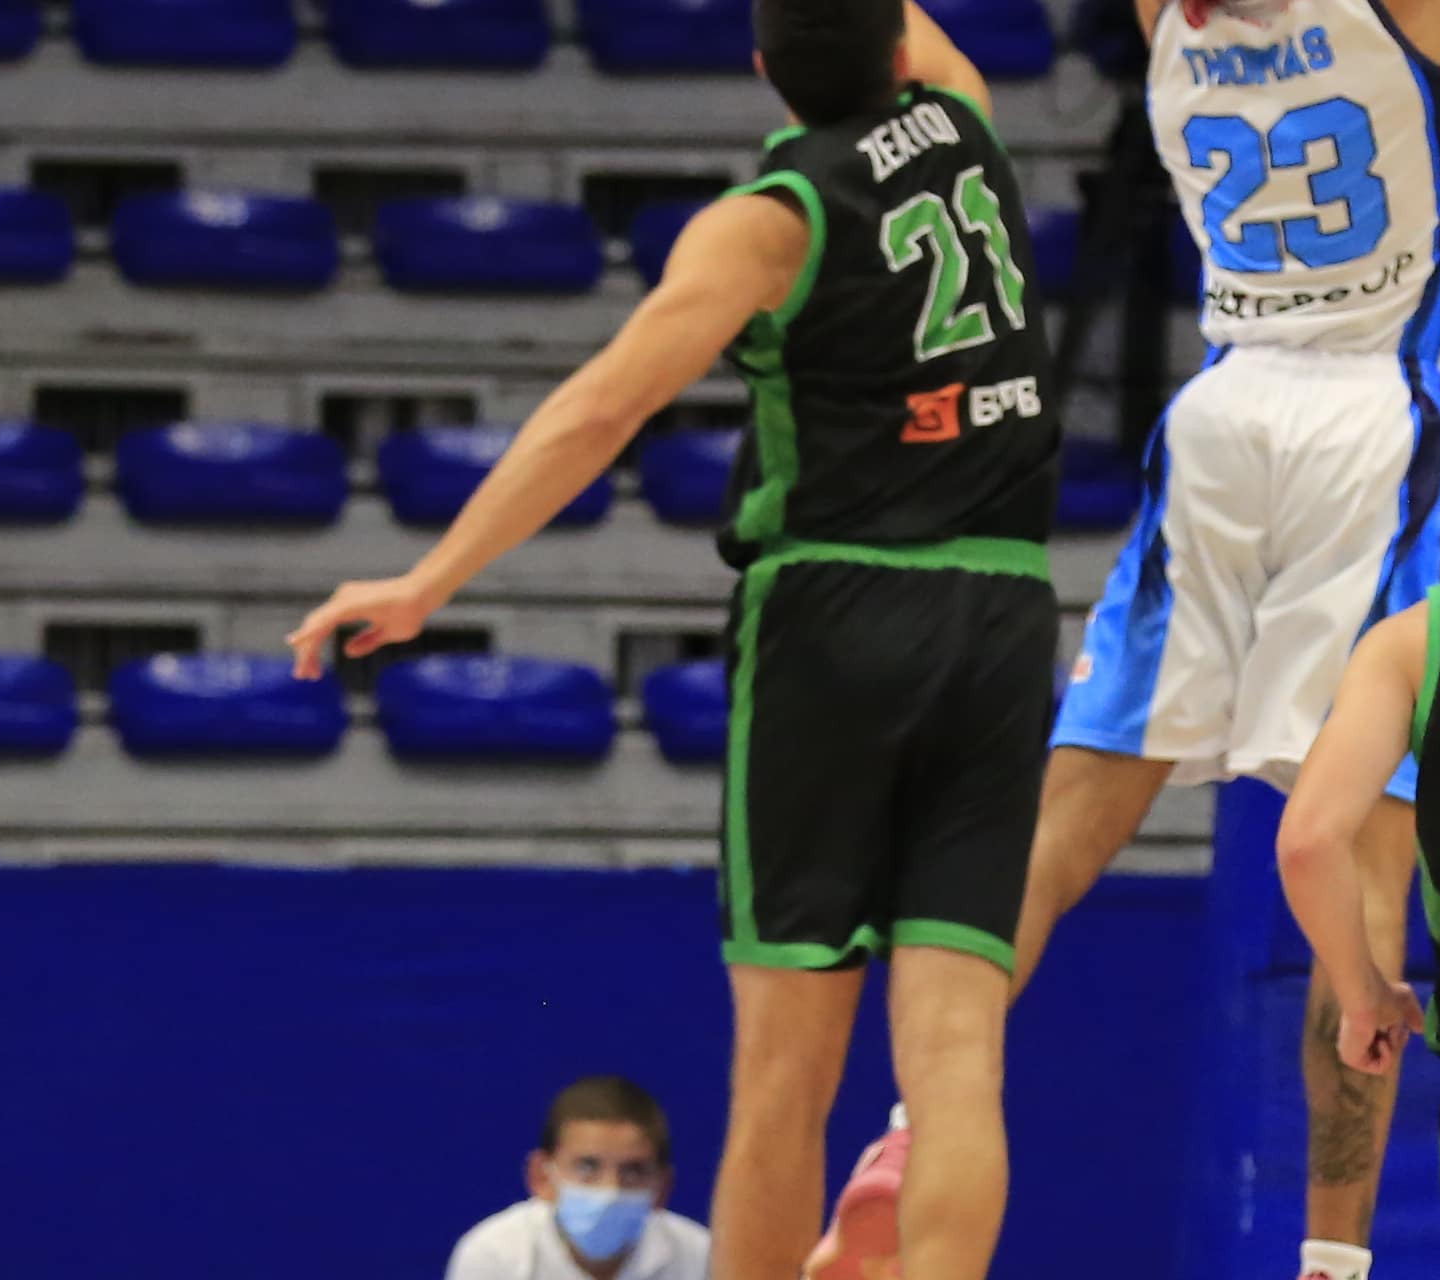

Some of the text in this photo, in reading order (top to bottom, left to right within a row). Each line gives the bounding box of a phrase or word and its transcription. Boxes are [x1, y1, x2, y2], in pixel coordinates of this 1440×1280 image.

[1182, 25, 1334, 86] THOMAS
[1182, 96, 1391, 273] 23
[880, 164, 1026, 363] 21
[969, 376, 1042, 427] BPB
